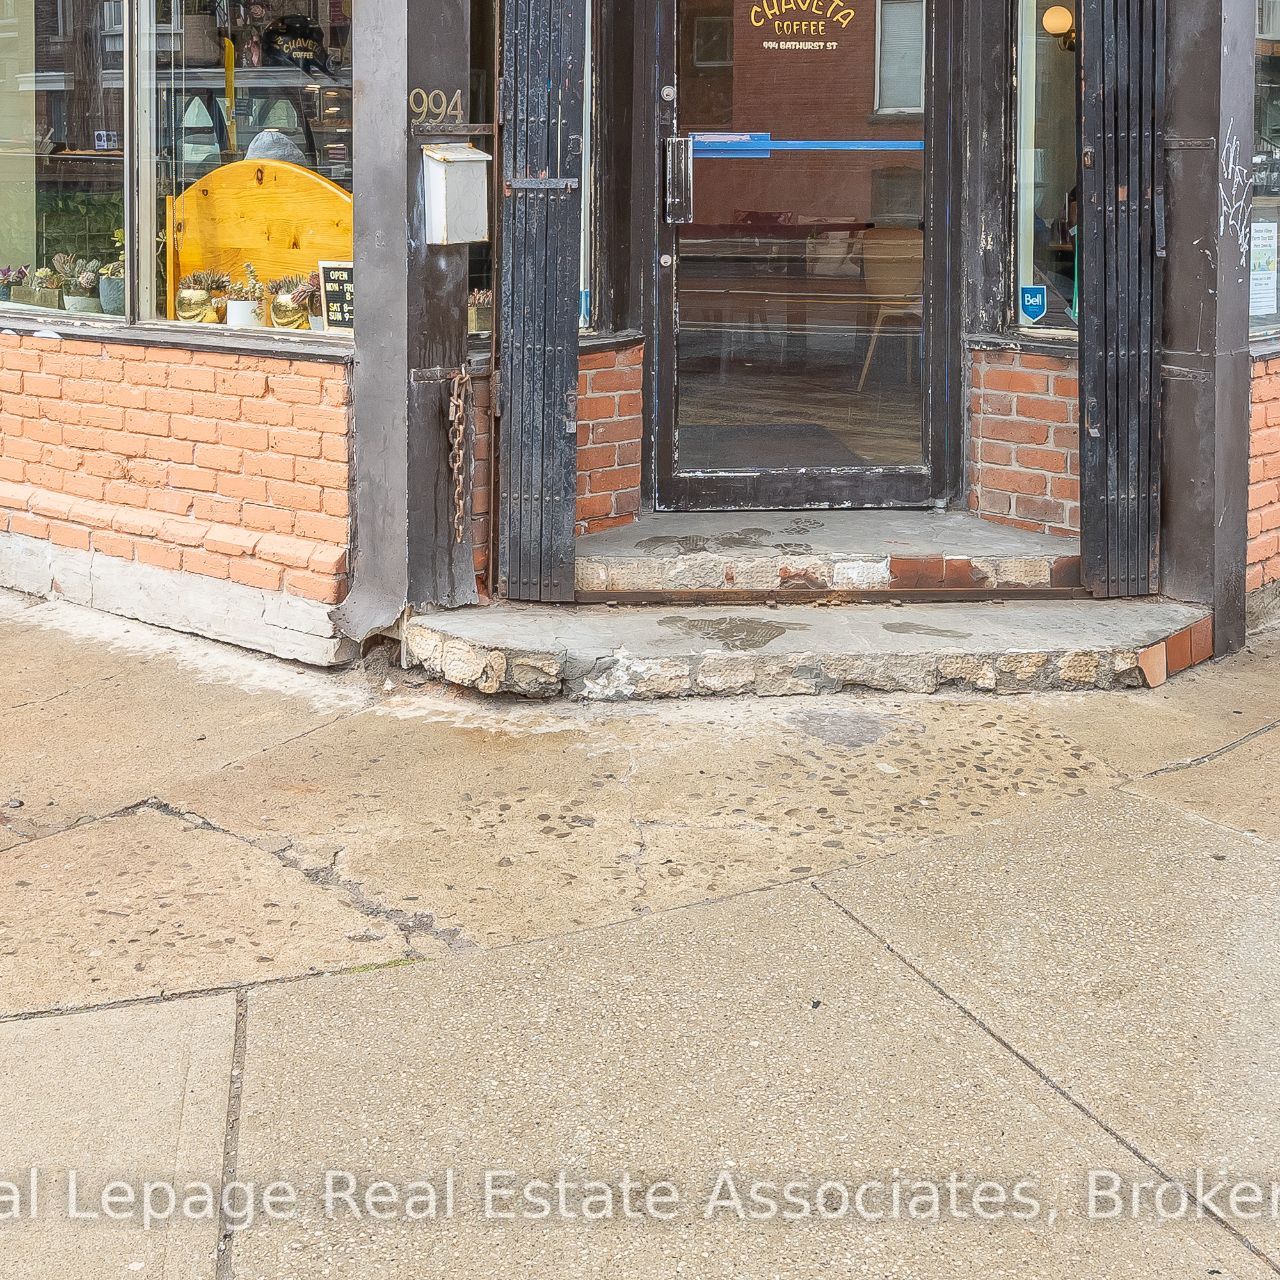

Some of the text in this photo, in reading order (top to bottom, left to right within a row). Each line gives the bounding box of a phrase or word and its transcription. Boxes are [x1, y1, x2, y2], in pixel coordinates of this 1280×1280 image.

[774, 20, 826, 35] COFFEE
[762, 41, 838, 50] 994 BATHURST ST
[292, 51, 314, 59] COFFEE
[409, 88, 464, 124] 994
[330, 271, 348, 280] OPEN
[325, 282, 339, 291] MON
[1024, 293, 1041, 305] Bell
[329, 303, 341, 311] SAT
[328, 312, 342, 321] SUN
